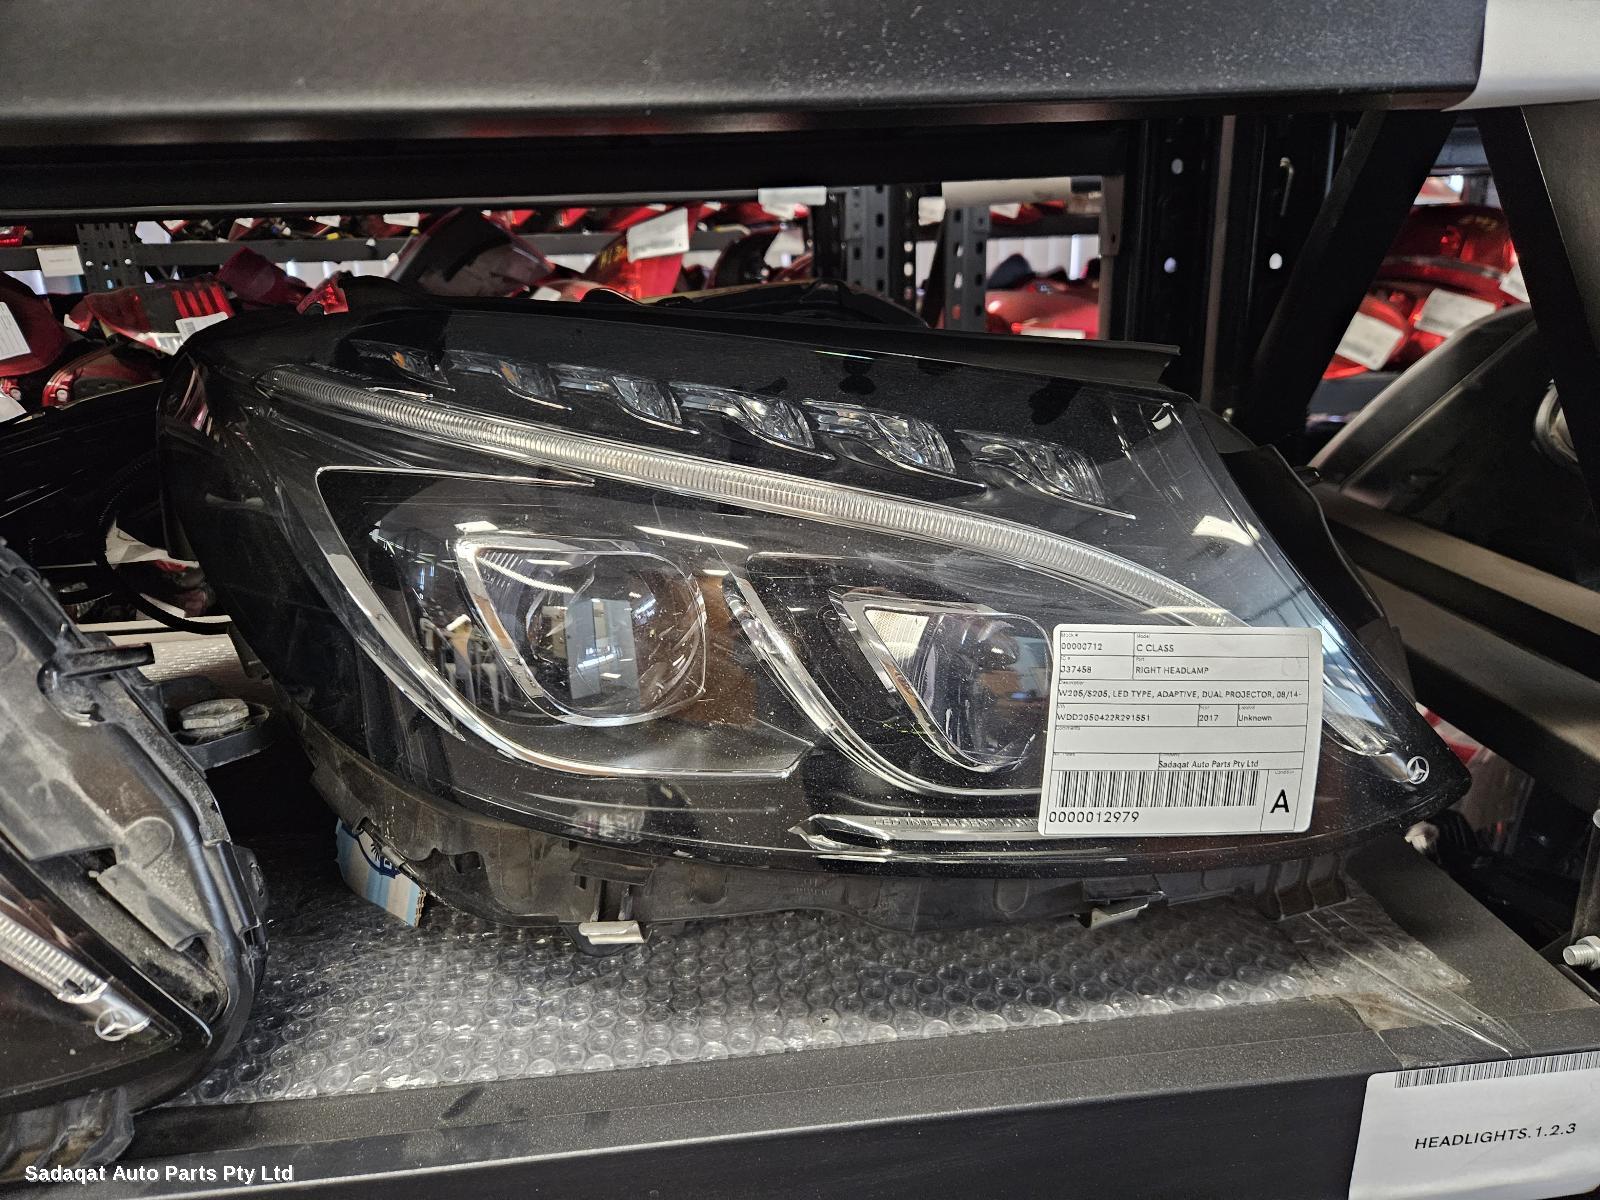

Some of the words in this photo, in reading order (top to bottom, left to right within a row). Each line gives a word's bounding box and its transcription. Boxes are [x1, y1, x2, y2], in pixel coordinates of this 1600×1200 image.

[1136, 644, 1143, 652] C
[1145, 644, 1174, 653] CLASS
[1135, 666, 1161, 674] RIGHT
[1163, 666, 1209, 675] HEADLAMP
[1059, 689, 1111, 699] W205/S205,
[1112, 690, 1129, 698] LED
[1131, 690, 1155, 699] TYPE,
[1156, 690, 1200, 700] ADAPTIVE,
[1202, 690, 1223, 699] DUAL
[1225, 690, 1275, 699] PROJECTOR,
[1199, 714, 1219, 722] 2017
[1238, 714, 1273, 722] Unknown
[1158, 760, 1189, 769] Sadaqat
[1191, 760, 1210, 768] Auto
[1211, 760, 1231, 768] Parts
[1233, 760, 1244, 768] Pty
[1246, 760, 1259, 768] Ltd
[1269, 789, 1290, 814] A
[874, 817, 899, 825] LED
[906, 817, 996, 826] INTELLIGENT
[1048, 811, 1140, 823] 0000012979
[1414, 1123, 1576, 1150] HEADLIGHTS.1.2.3
